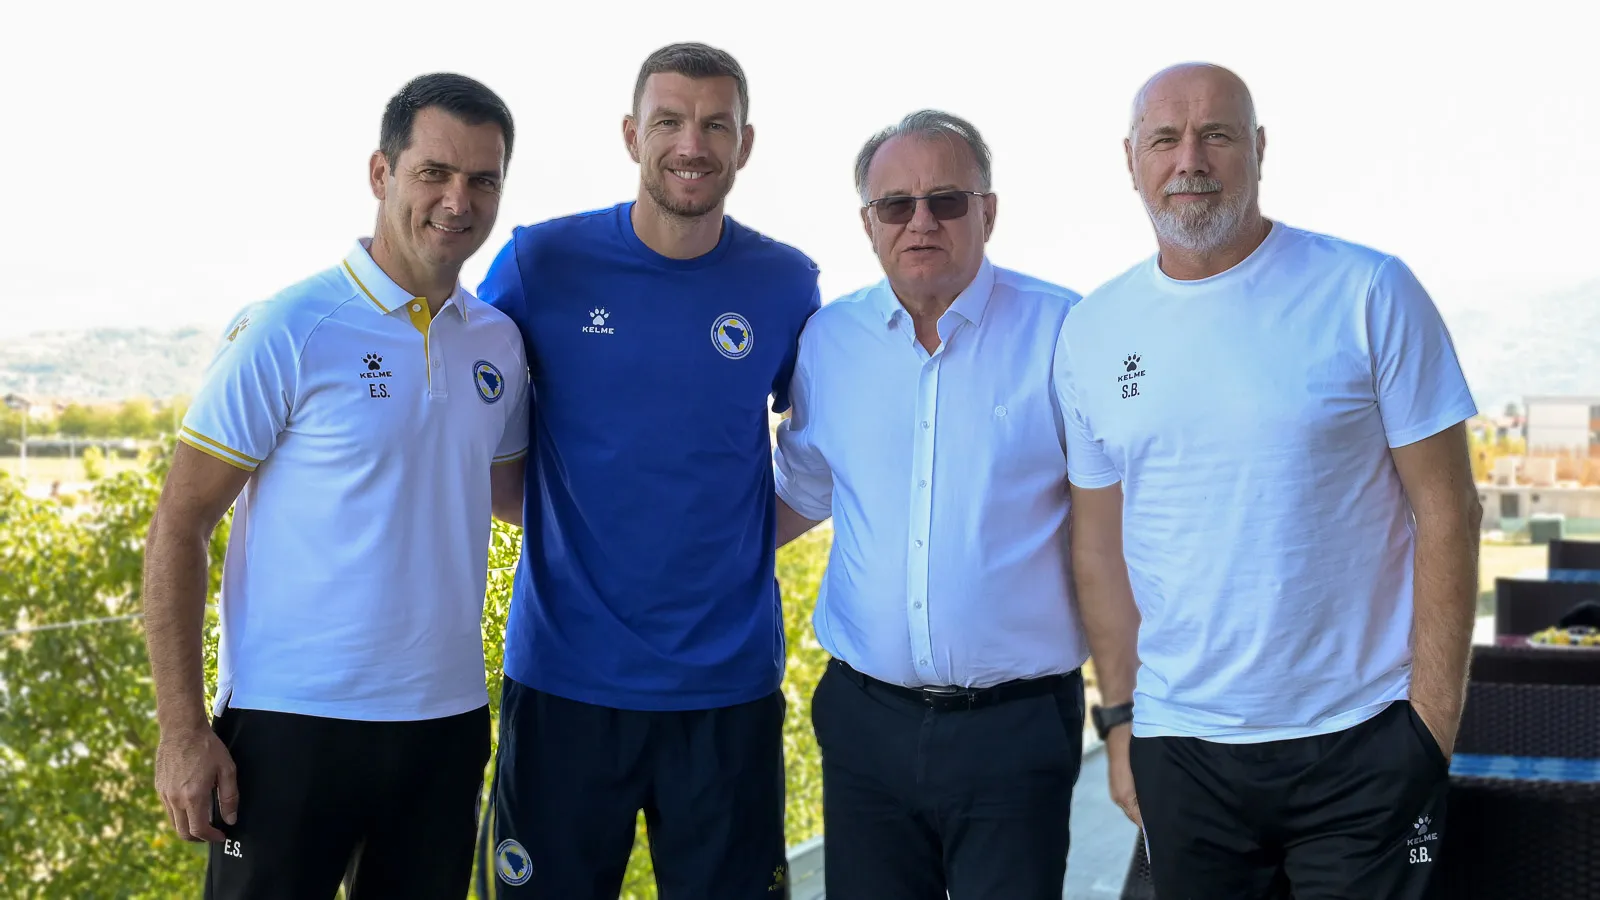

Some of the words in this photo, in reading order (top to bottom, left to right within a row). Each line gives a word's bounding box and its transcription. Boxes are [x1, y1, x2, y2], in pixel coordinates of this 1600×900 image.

[582, 326, 615, 335] KELME
[359, 371, 393, 379] KELME
[1117, 370, 1146, 382] KELME
[369, 383, 391, 398] E.S.
[1121, 382, 1140, 399] S.B.
[1407, 832, 1438, 846] KELME
[224, 838, 243, 858] E.S.
[1409, 846, 1432, 864] S.B.
